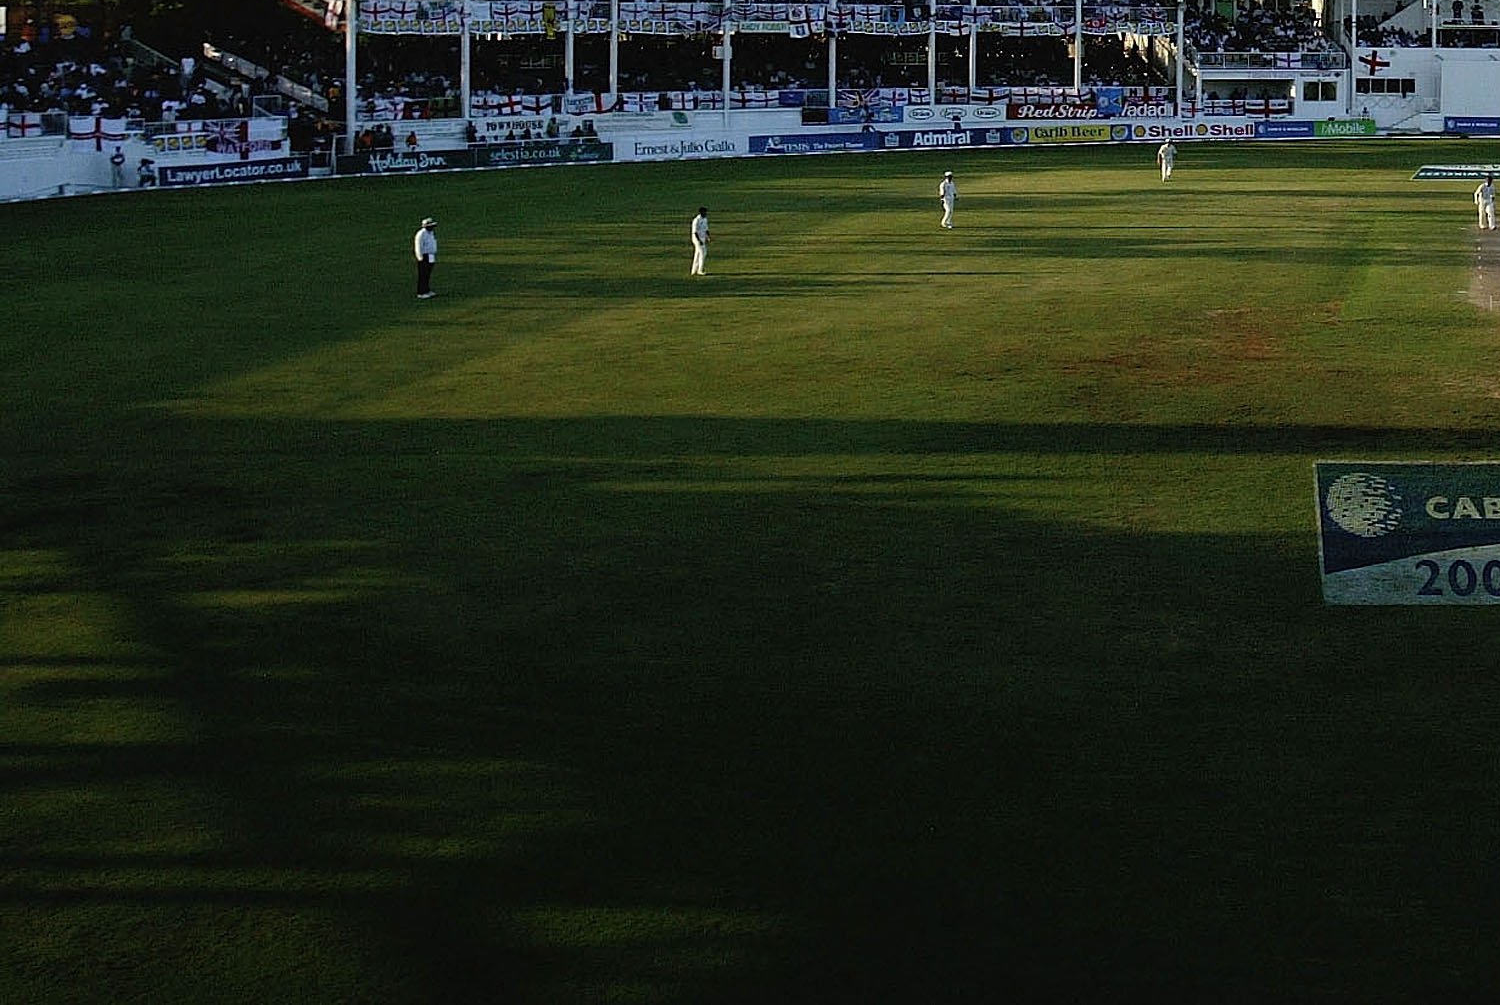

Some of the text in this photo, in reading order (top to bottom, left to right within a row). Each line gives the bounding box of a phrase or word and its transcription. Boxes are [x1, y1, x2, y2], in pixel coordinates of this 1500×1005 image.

[1017, 104, 1056, 117] Red
[1056, 104, 1104, 119] Strip
[1034, 126, 1105, 138] Carib Beer
[1148, 124, 1193, 137] Shell
[1210, 123, 1253, 136] Shell
[913, 131, 971, 145] Admiral
[634, 139, 736, 157] Ernest & Julio Gallo
[368, 153, 447, 172] Holiday Inn
[167, 160, 302, 183] LawyerLocator.co.uk
